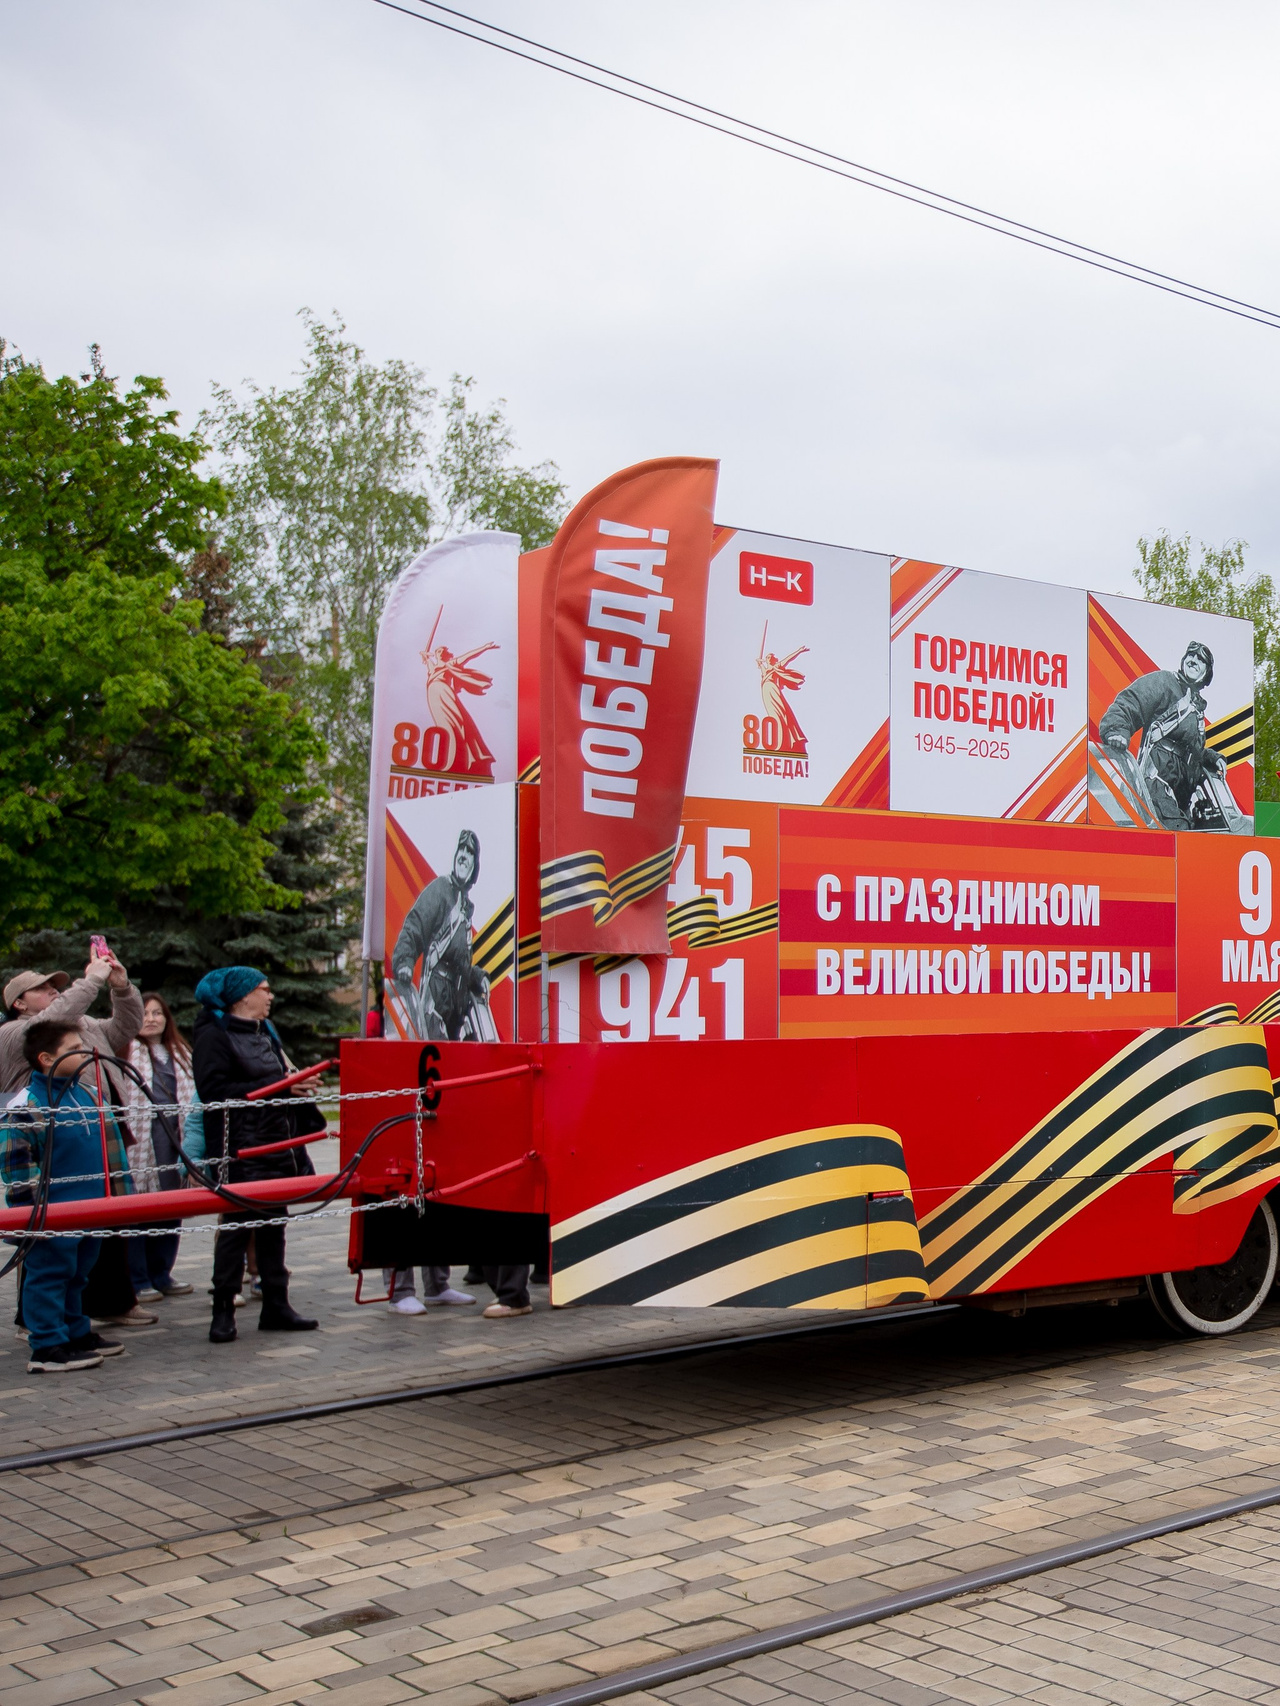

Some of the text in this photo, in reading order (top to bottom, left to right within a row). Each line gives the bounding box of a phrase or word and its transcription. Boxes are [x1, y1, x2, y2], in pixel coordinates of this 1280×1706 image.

[580, 518, 674, 819] ПОБЕДА!
[914, 632, 1068, 689] ГОРДИМСЯ
[742, 713, 780, 751] 80
[914, 680, 1055, 735] ПОБЕДОЙ!
[391, 721, 451, 772] 80
[742, 755, 810, 780] ПОБЕДА!
[387, 775, 484, 800] ПОБЕ
[668, 825, 753, 921] 45
[1237, 850, 1274, 937] 9
[815, 873, 1101, 932] С ПРАЗДНИКОМ
[548, 957, 745, 1044] 1941
[816, 944, 1152, 1000] ВЕЛИКОЙ ПОБЕДЫ!
[418, 1044, 442, 1110] 6
